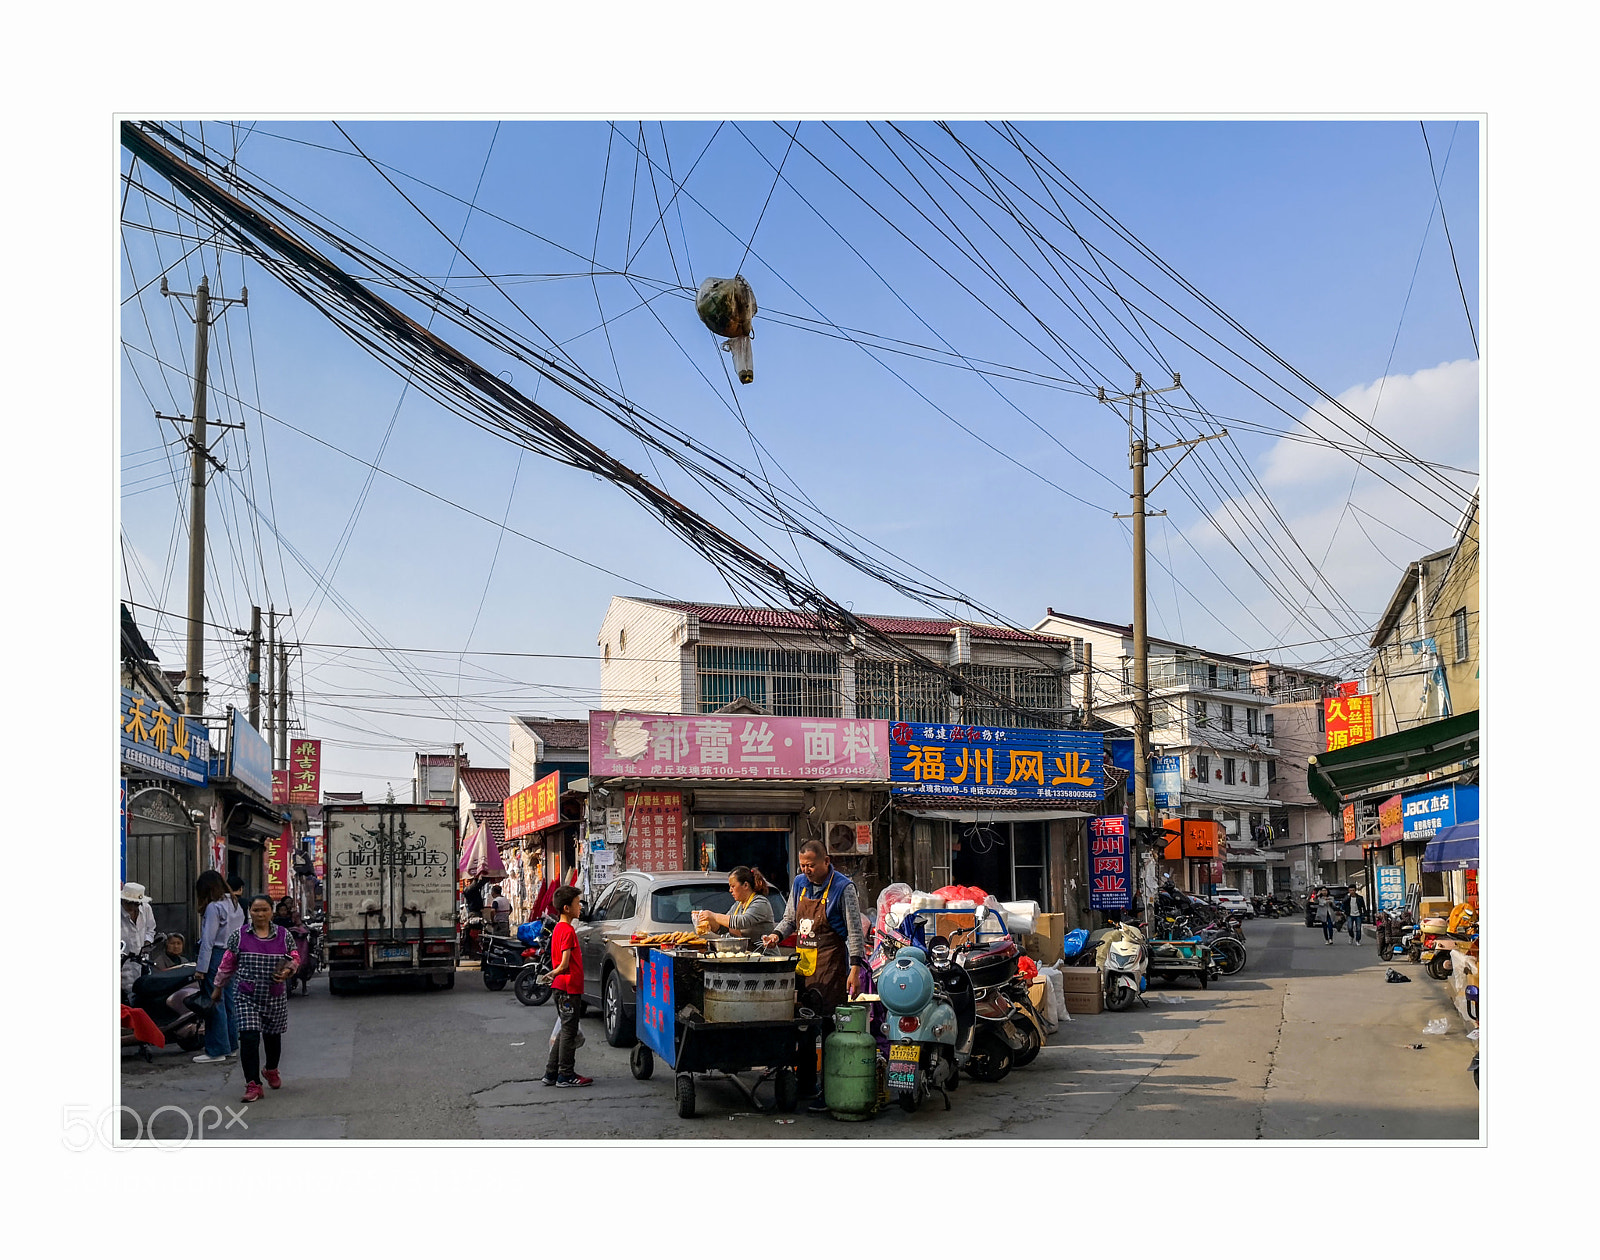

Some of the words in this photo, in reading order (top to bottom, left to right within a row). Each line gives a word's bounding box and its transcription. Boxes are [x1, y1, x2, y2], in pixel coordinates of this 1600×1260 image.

[120, 697, 190, 761] 禾布业
[602, 716, 879, 764] 都蕾丝·面料
[1327, 700, 1348, 752] 久源
[291, 742, 317, 793] 鼎吉布业
[765, 767, 792, 776] TEL:
[902, 744, 1095, 787] 福州网业
[1430, 794, 1449, 813] 杰克
[629, 838, 677, 848] 水溶蕾丝
[629, 850, 678, 860] 水溶对花
[1090, 817, 1127, 893] 福州网业
